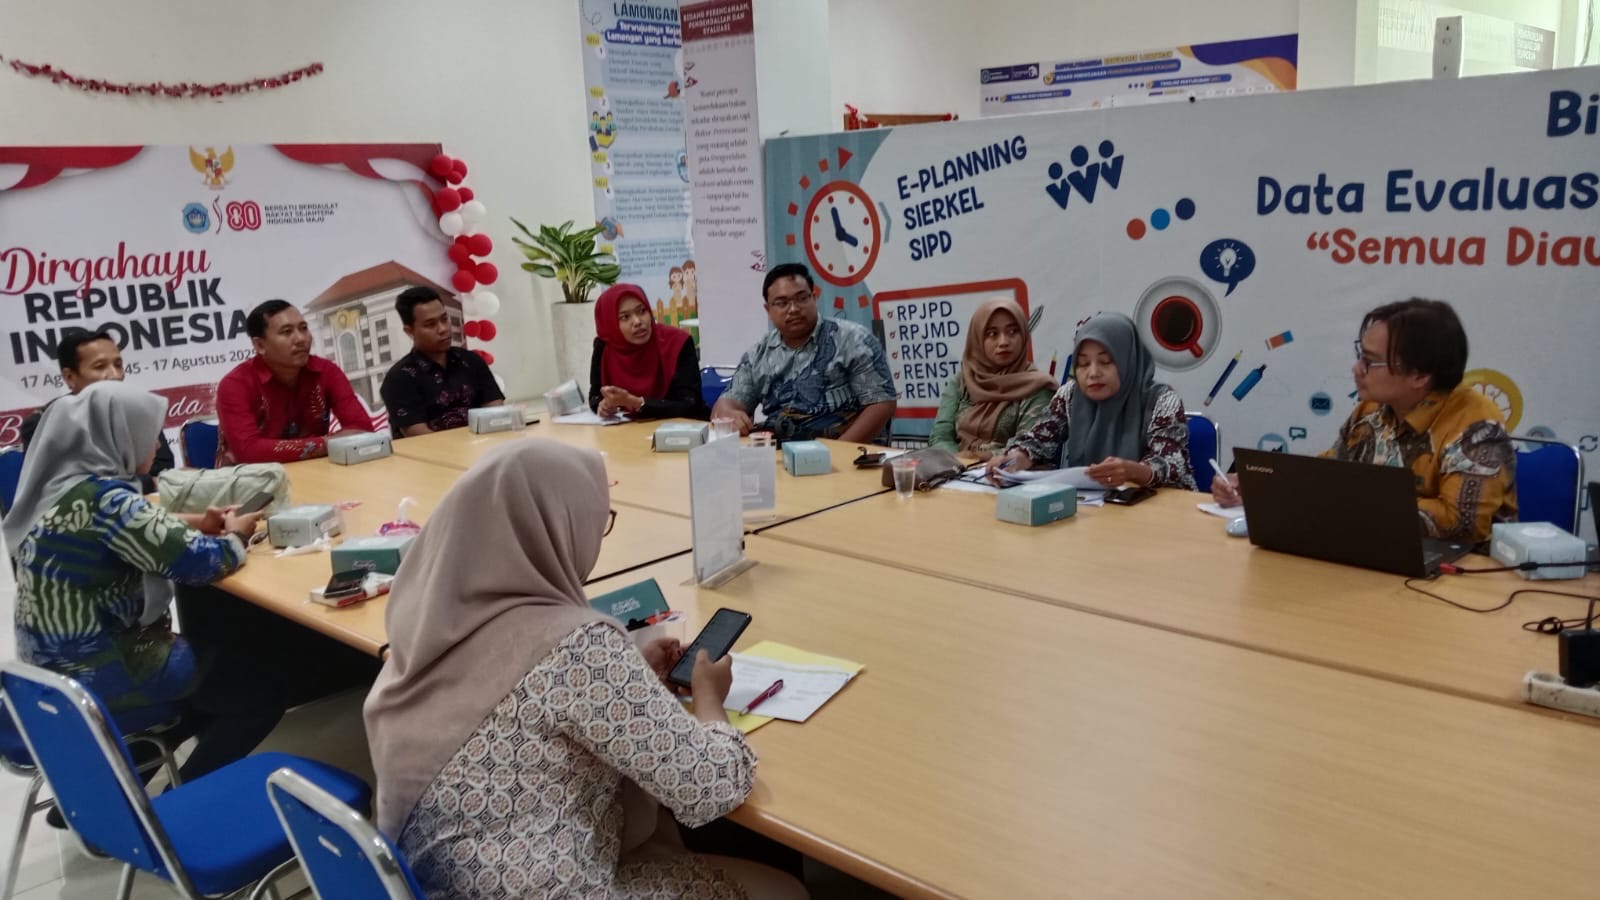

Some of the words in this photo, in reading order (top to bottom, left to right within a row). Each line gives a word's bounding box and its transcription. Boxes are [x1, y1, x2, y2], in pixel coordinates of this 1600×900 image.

[613, 2, 678, 21] LAMONGAN
[1547, 90, 1600, 137] Bi
[897, 135, 1027, 199] E-PLANNING
[1257, 173, 1365, 216] Data
[1386, 167, 1600, 213] Evaluas
[226, 200, 262, 231] 80
[903, 186, 985, 230] SIERKEL
[909, 230, 952, 261] SIPD
[0, 241, 211, 299] Dirgahayu
[24, 277, 226, 324] REPUBLIK
[897, 300, 953, 321] RPJPD
[10, 309, 248, 365] INONESIA
[898, 320, 960, 341] RPJMD
[901, 342, 948, 360] RKPD
[20, 375, 38, 388] 17
[152, 359, 169, 372] 17
[171, 352, 226, 371] Agustus
[904, 361, 962, 380] RENST
[905, 382, 944, 399] REN
[1246, 463, 1274, 474] Lenovo
